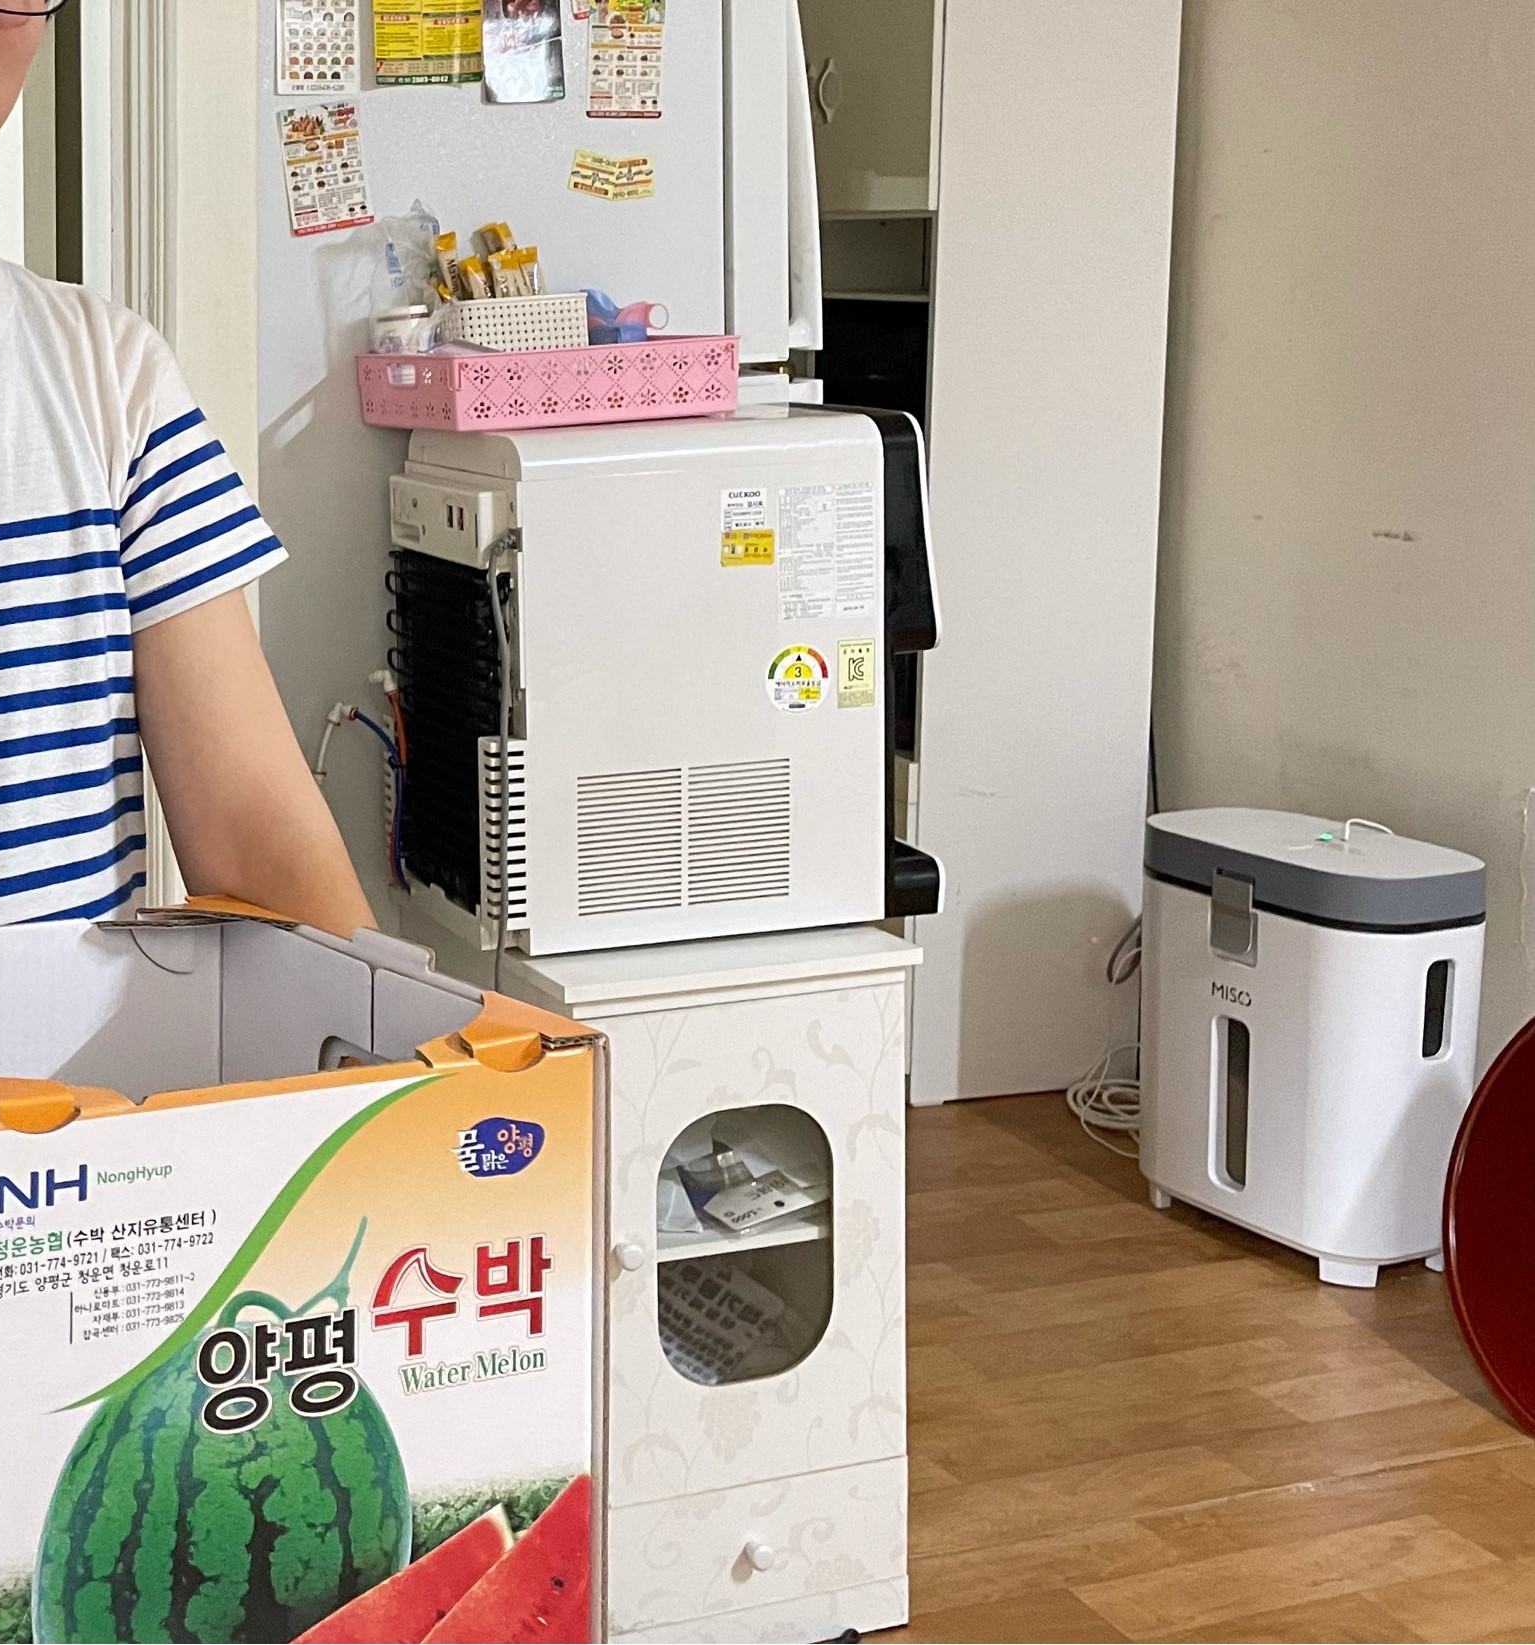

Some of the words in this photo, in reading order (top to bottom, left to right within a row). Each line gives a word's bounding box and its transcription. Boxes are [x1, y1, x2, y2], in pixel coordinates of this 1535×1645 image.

[794, 667, 802, 678] 3
[1211, 981, 1252, 1007] MISO
[450, 1129, 485, 1173] 물
[482, 1149, 510, 1172] 맑은
[496, 1123, 535, 1158] 양평
[96, 1163, 173, 1186] NongHyup
[34, 1272, 73, 1292] 양평군
[369, 1234, 553, 1358] 수박
[197, 1307, 359, 1434] 양평
[400, 1360, 470, 1393] Water
[475, 1347, 547, 1379] Melon
